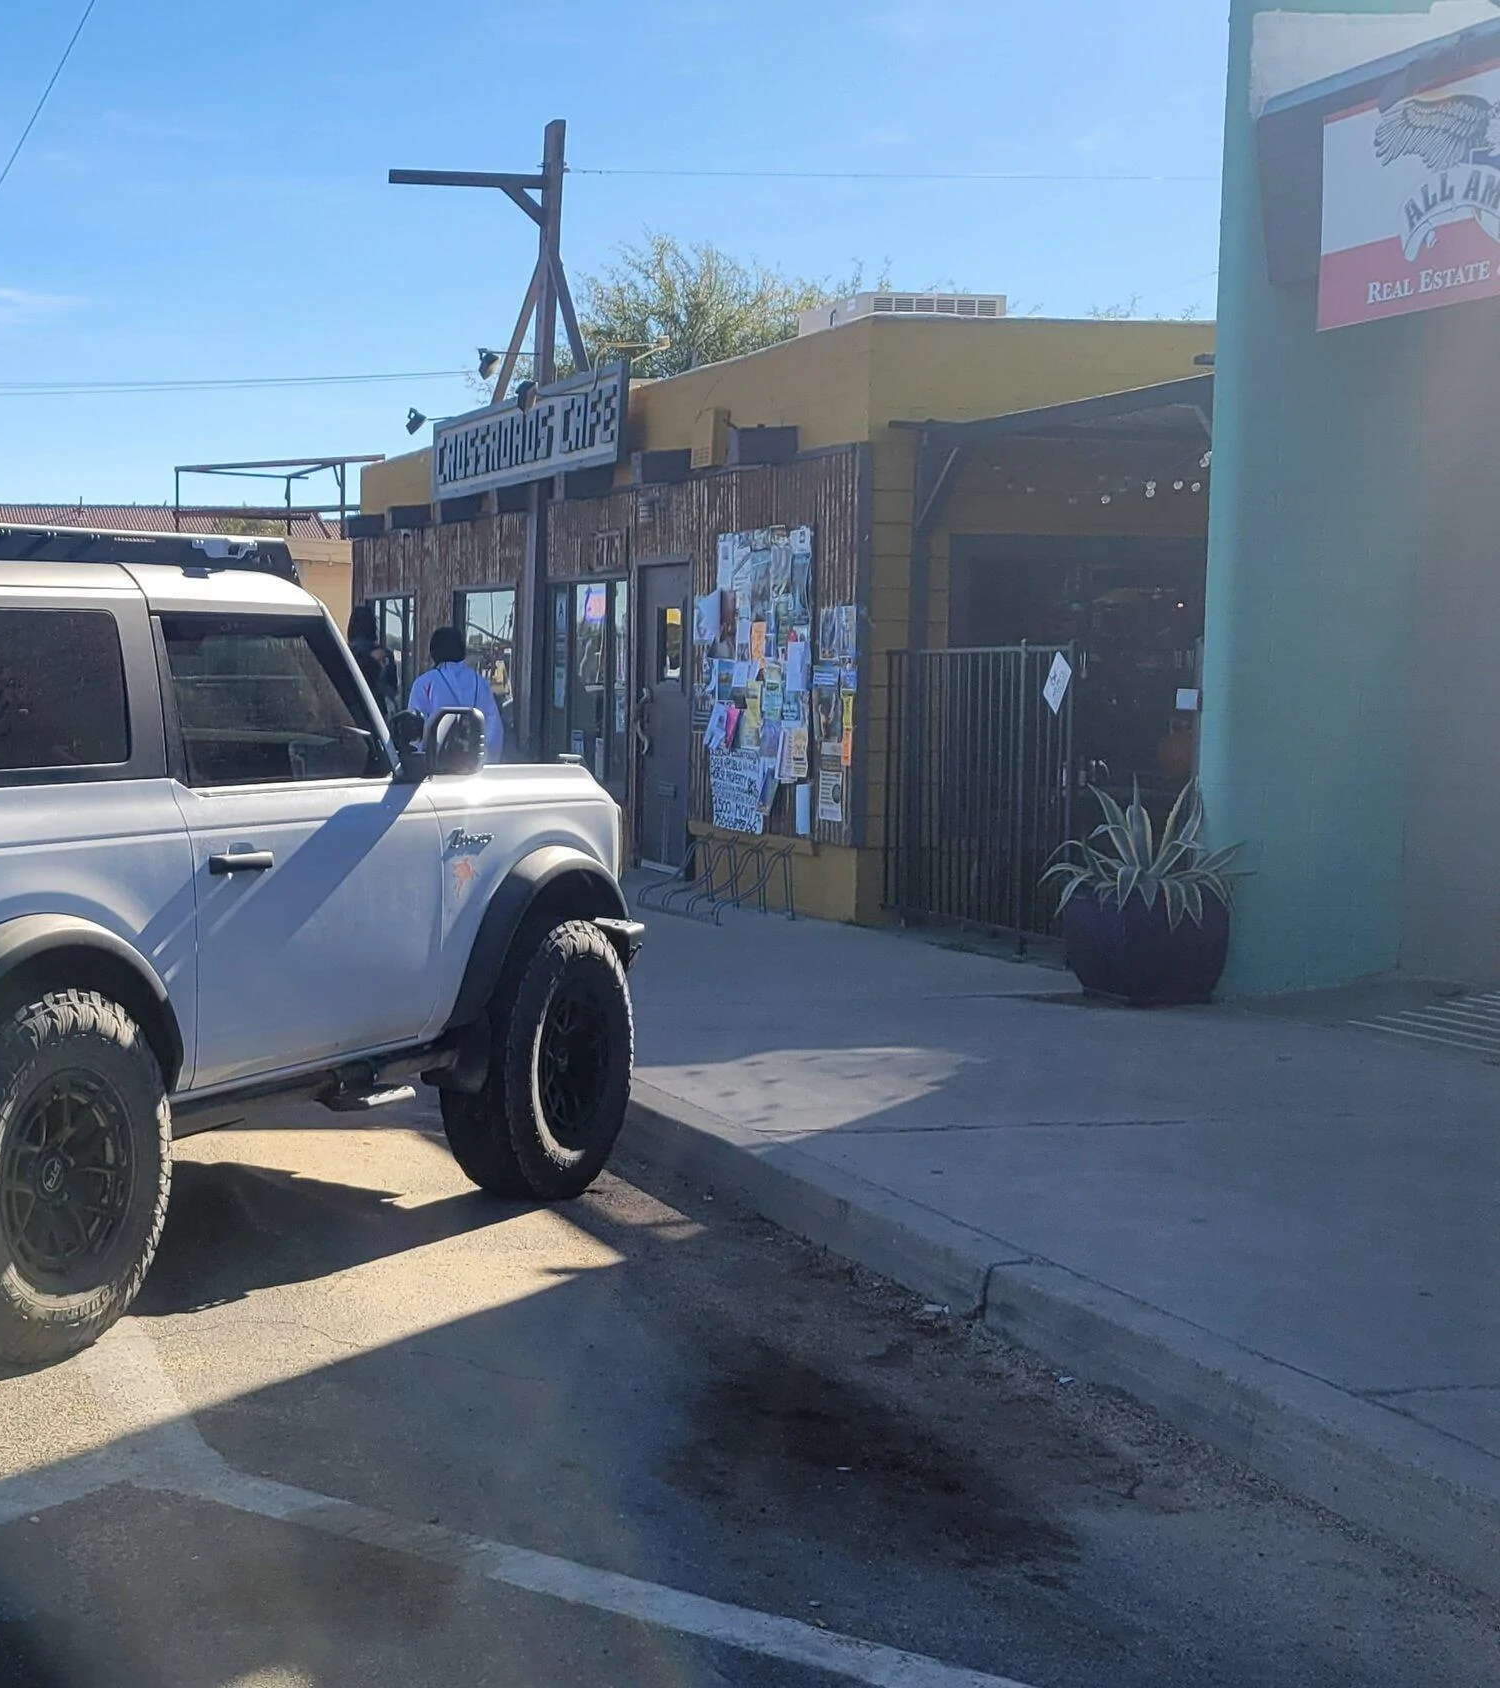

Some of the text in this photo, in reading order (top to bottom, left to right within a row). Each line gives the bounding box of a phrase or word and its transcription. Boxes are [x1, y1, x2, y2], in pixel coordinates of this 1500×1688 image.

[1403, 172, 1455, 232] ALL
[1366, 260, 1491, 304] REAL ESTATE
[436, 384, 618, 485] CROSSROADS CAFE
